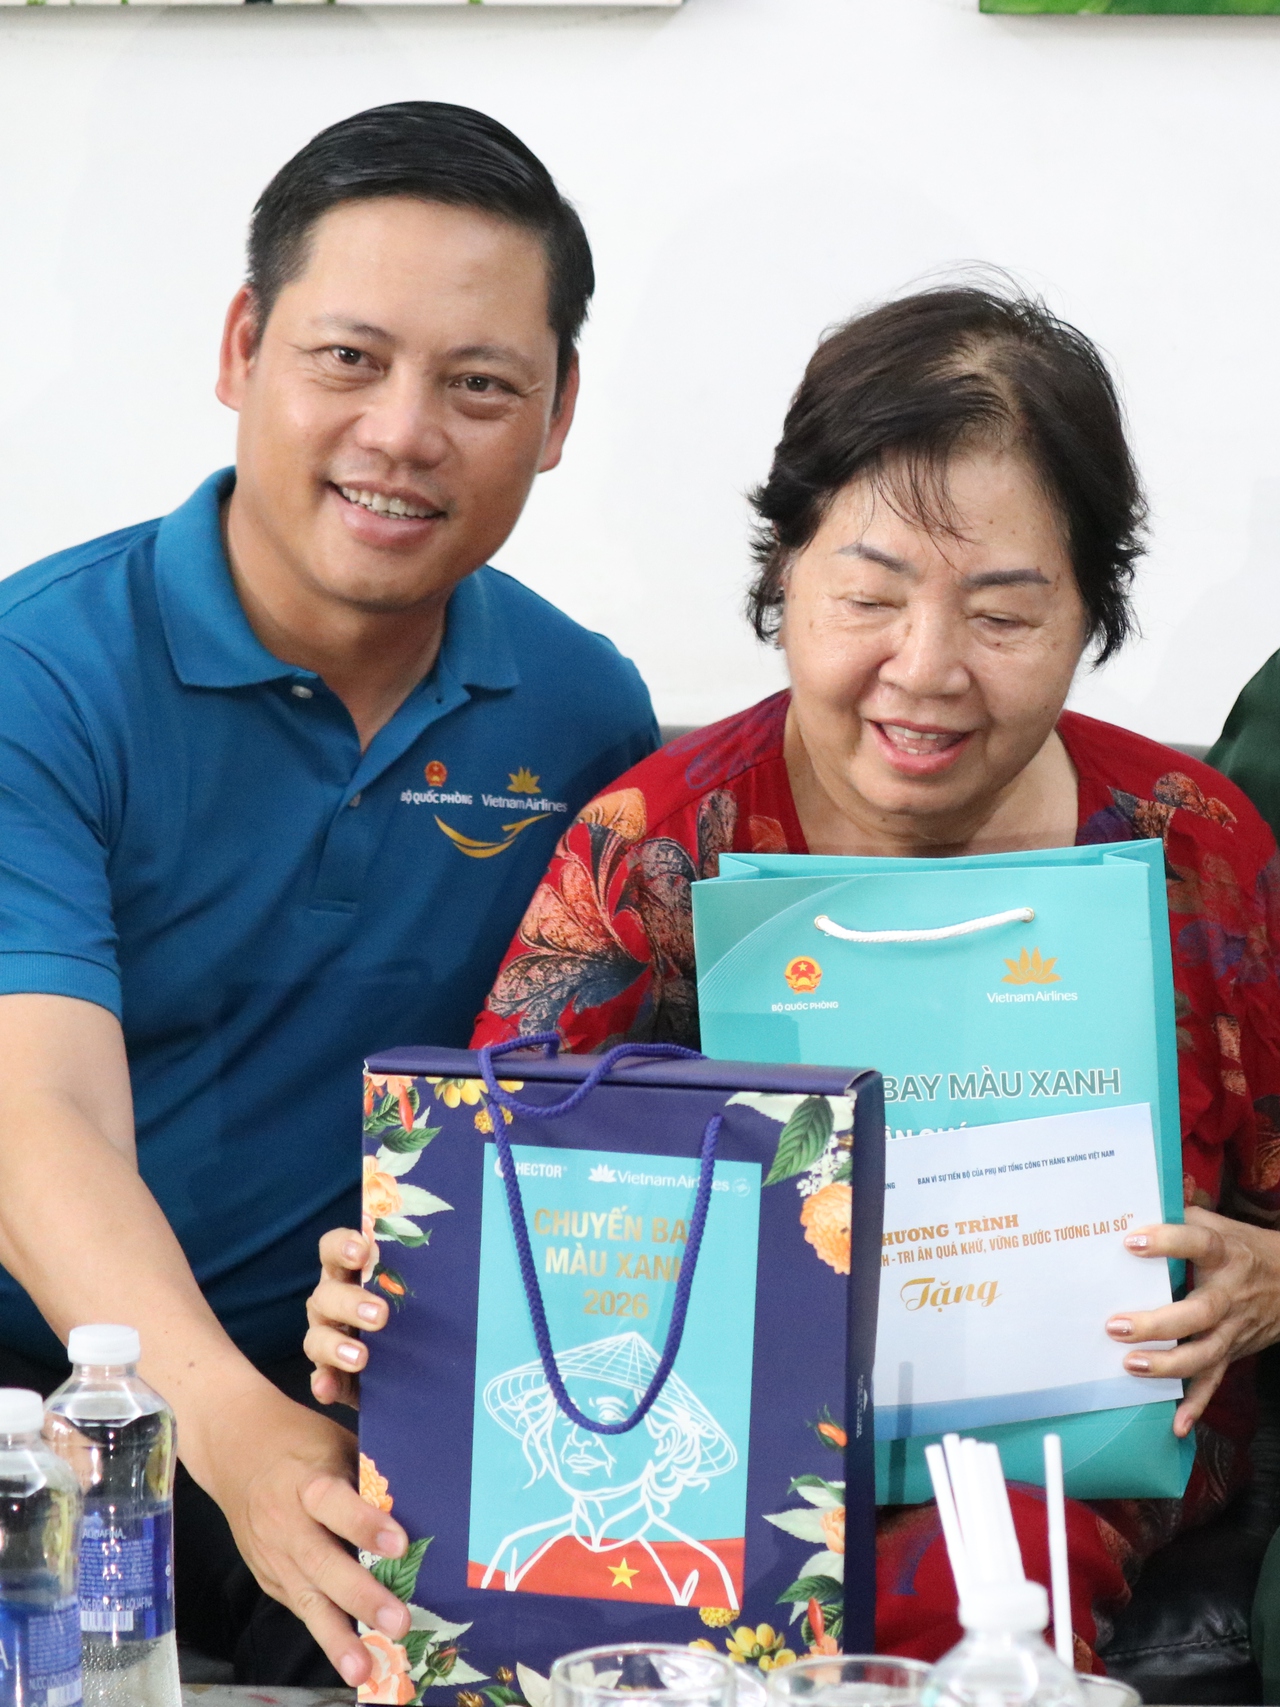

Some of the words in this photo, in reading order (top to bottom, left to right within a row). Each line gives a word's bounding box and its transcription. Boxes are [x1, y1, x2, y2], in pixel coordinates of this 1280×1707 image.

[400, 790, 412, 804] BỘ
[413, 789, 439, 805] QUỐC
[440, 791, 473, 805] PHÒNG
[771, 1002, 783, 1013] BỘ
[784, 1001, 808, 1011] QUỐC
[809, 1000, 839, 1010] PHÒNG
[883, 1073, 942, 1103] BAY
[948, 1065, 1023, 1100] MÀU
[1028, 1067, 1121, 1097] XANH
[917, 1177, 930, 1185] BAN
[931, 1175, 938, 1183] VÌ
[938, 1173, 946, 1182] SỰ
[947, 1171, 961, 1181] TIẾN
[962, 1170, 971, 1179] BỘ
[971, 1167, 984, 1178] CỦA
[984, 1166, 997, 1176] PHỤ
[998, 1165, 1007, 1174] NỮ
[1008, 1161, 1023, 1172] TỔNG
[1024, 1160, 1041, 1170] CÔNG
[1041, 1159, 1049, 1167] TY
[1049, 1156, 1066, 1166] HÀNG
[1066, 1153, 1087, 1164] KHÔNG
[1087, 1150, 1100, 1160] VIỆT
[1101, 1149, 1115, 1159] NAM
[534, 1205, 643, 1242] CHUYẾN
[651, 1217, 693, 1245] BA
[881, 1223, 949, 1247] HƯƠNG
[955, 1214, 1019, 1236] TRÌNH
[897, 1249, 915, 1265] TRI
[917, 1246, 933, 1262] ÂN
[936, 1241, 958, 1260] QUÁ
[960, 1238, 987, 1255] KHỨ,
[989, 1234, 1019, 1251] VỮNG
[1022, 1228, 1052, 1247] BƯỚC
[1054, 1224, 1090, 1242] TƯƠNG
[1093, 1220, 1110, 1236] LAI
[545, 1242, 607, 1277] MÀU
[583, 1289, 649, 1319] 2026
[900, 1277, 1003, 1313] Tặng
